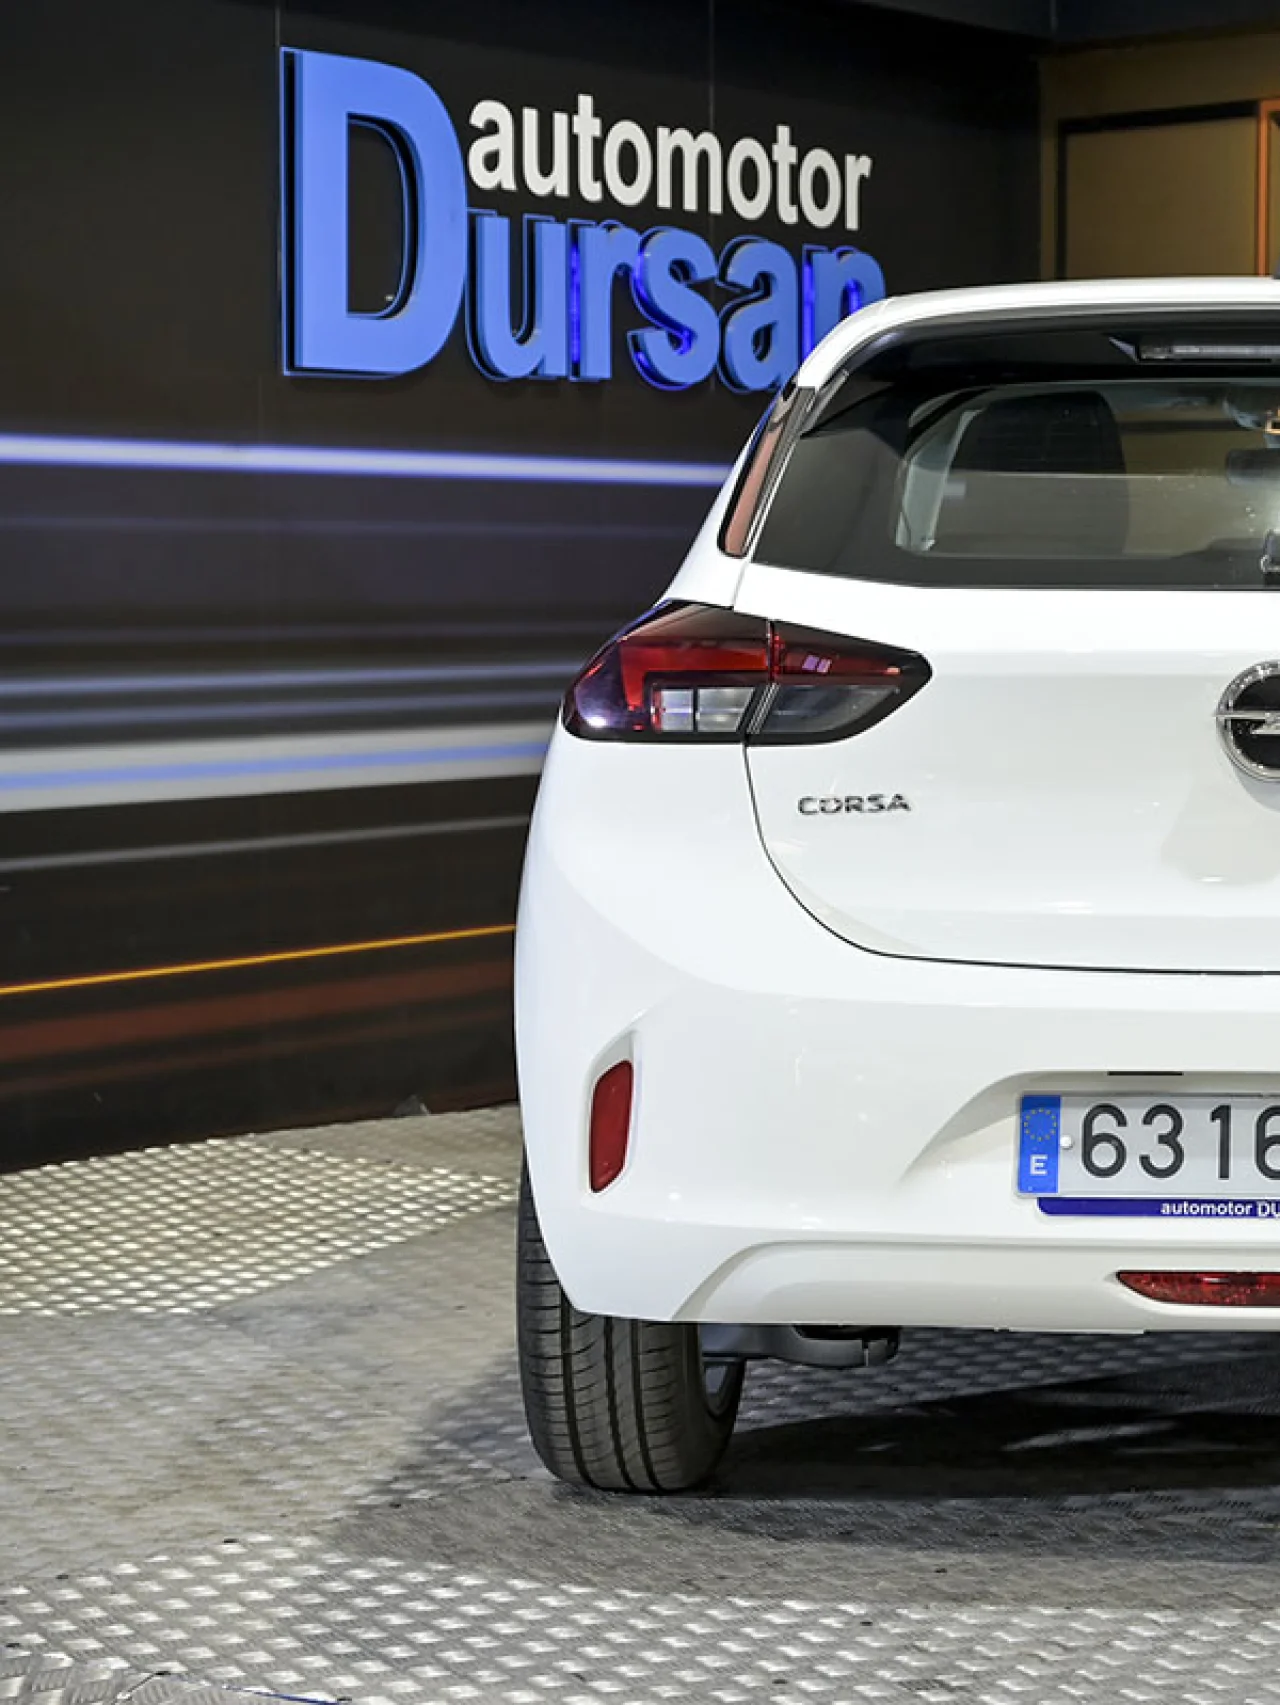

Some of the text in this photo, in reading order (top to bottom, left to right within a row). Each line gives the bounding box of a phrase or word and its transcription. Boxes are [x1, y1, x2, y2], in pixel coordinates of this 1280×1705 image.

[467, 94, 873, 231] automotor
[280, 46, 887, 393] Dursan
[798, 794, 911, 815] CORSA
[1029, 1155, 1048, 1176] E
[1160, 1200, 1253, 1216] automotor
